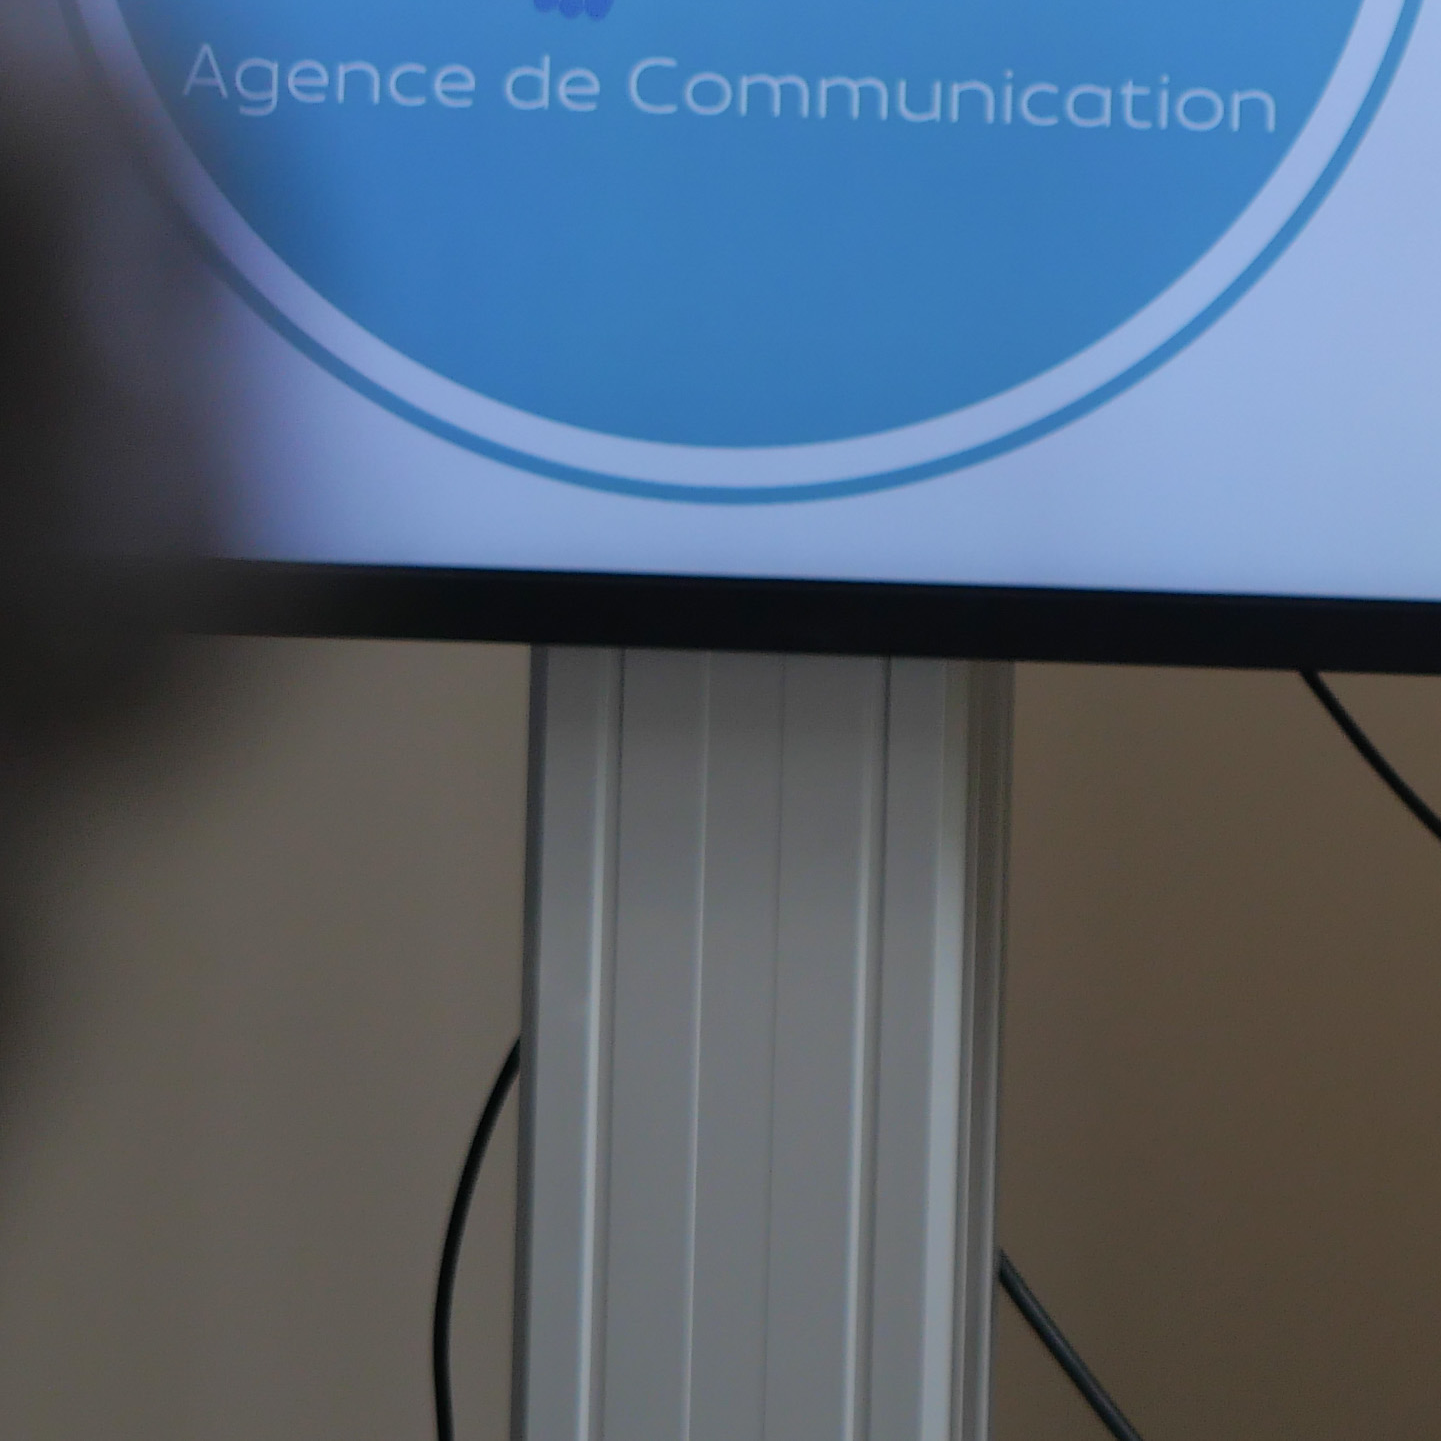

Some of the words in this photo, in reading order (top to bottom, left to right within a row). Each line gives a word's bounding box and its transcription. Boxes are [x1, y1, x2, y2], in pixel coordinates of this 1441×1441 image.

[183, 42, 477, 117] Agence
[504, 55, 601, 112] de
[627, 57, 1276, 133] Communication
